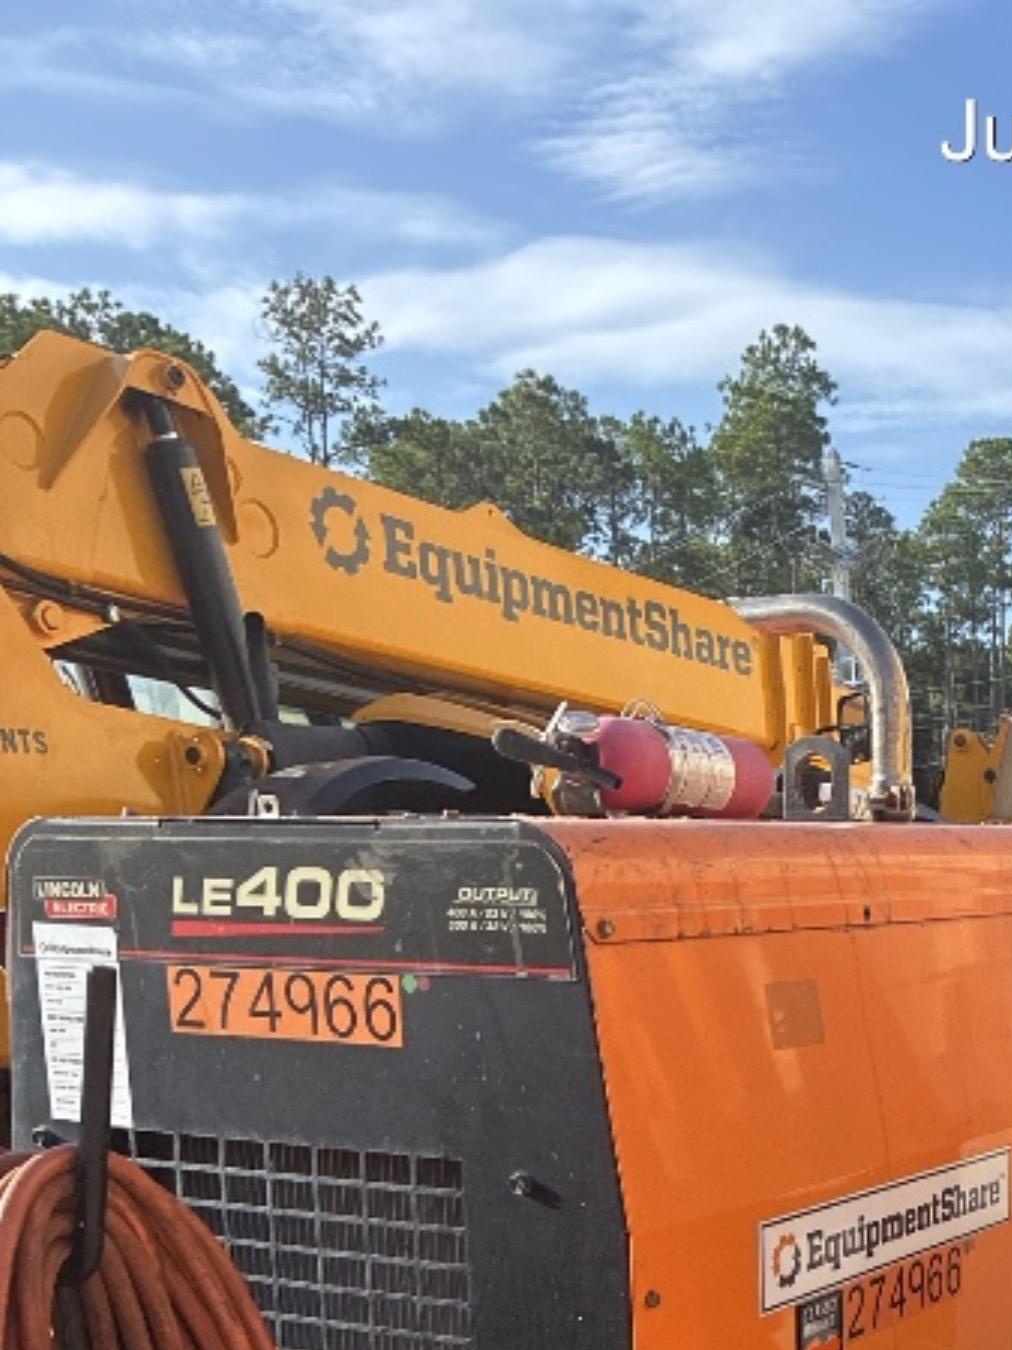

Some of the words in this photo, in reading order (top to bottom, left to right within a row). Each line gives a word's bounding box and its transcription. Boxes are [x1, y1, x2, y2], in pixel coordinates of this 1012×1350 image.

[380, 512, 752, 676] EquipmentShare
[172, 866, 385, 920] LE400
[458, 887, 535, 901] OUTPUT
[174, 968, 397, 1041] 274966
[806, 1180, 1001, 1270] EquipmentShare
[848, 1247, 961, 1340] 274966
